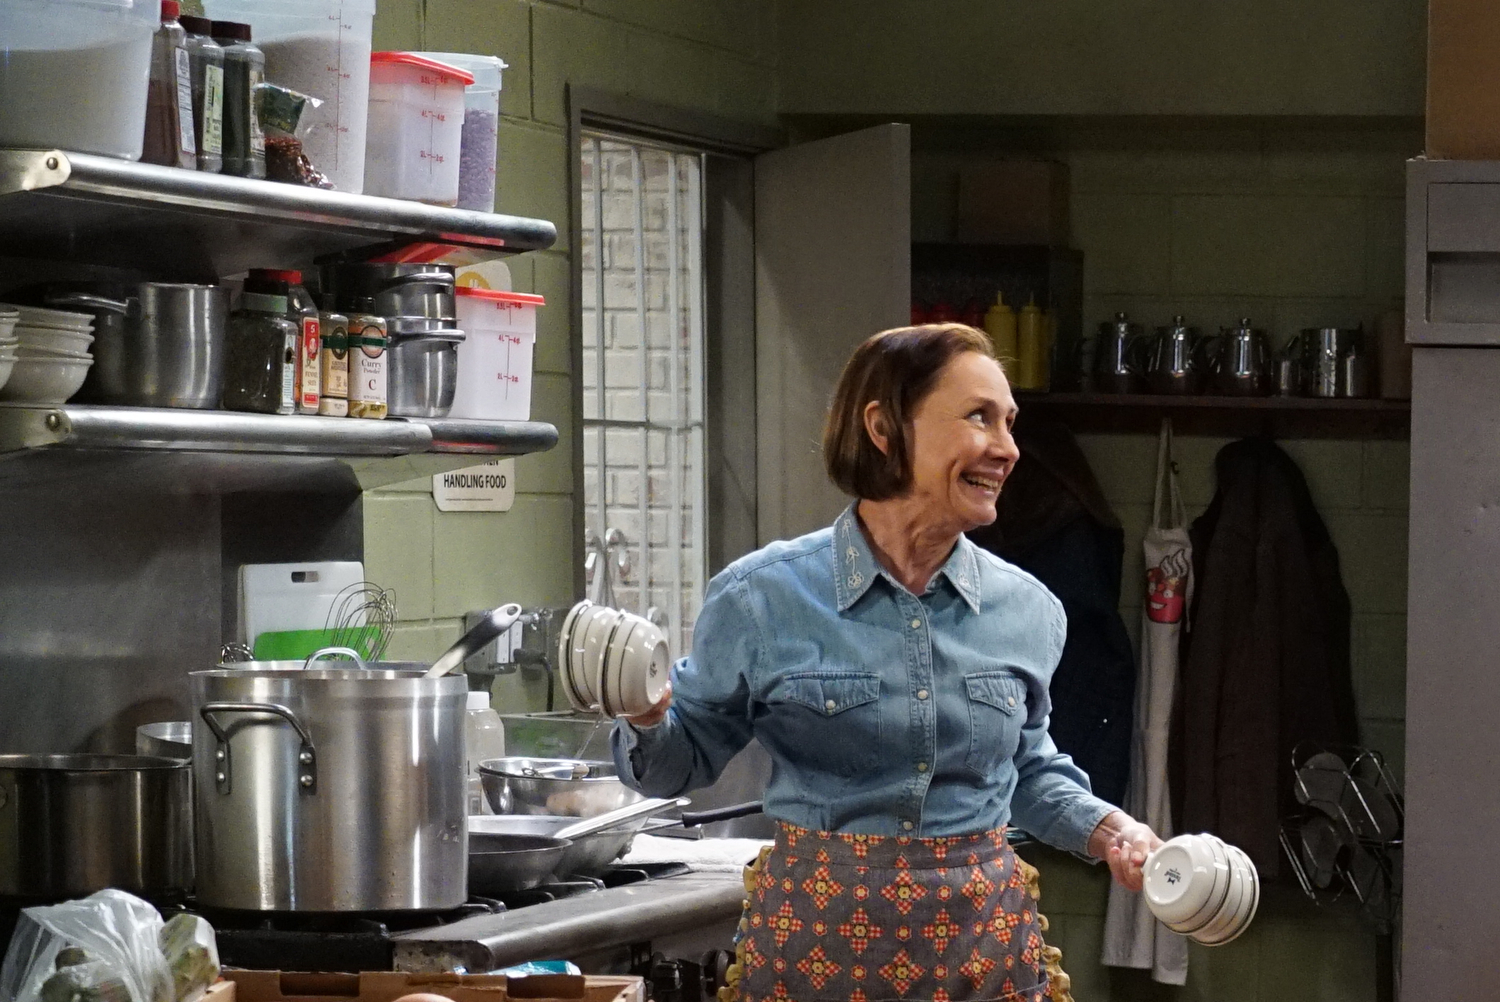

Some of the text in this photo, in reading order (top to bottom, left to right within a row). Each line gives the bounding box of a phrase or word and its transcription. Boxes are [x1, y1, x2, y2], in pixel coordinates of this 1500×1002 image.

[361, 359, 382, 368] Curry
[368, 379, 377, 390] C
[443, 474, 507, 488] HANDLING FOOD
